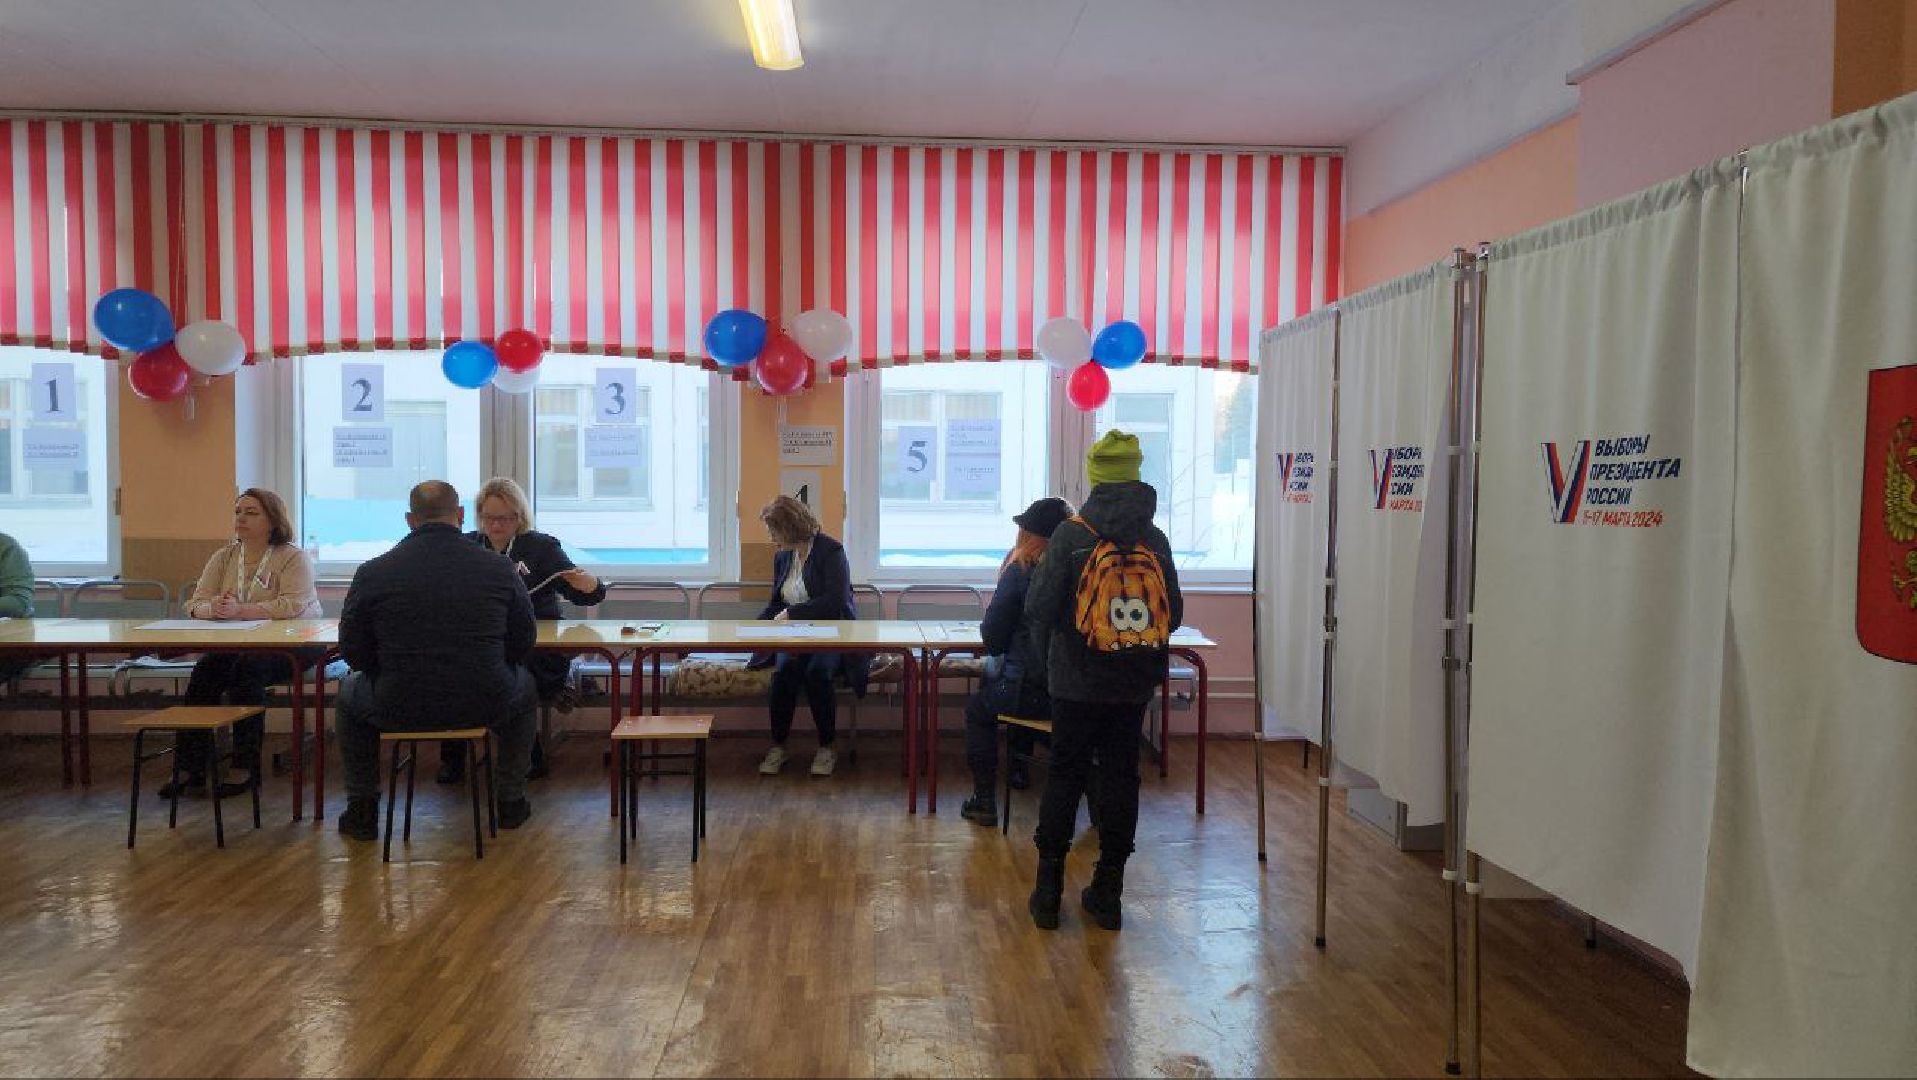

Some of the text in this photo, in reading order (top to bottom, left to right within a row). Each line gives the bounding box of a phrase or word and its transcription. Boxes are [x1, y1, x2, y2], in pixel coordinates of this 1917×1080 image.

[45, 379, 62, 413] 1
[350, 379, 373, 412] 2
[605, 382, 625, 414] 3
[907, 440, 928, 471] 5
[1594, 434, 1650, 457] ВЫБОРЫ
[1589, 458, 1681, 482] ПРЕЗИДЕНТА
[1631, 510, 1663, 528] 2024
